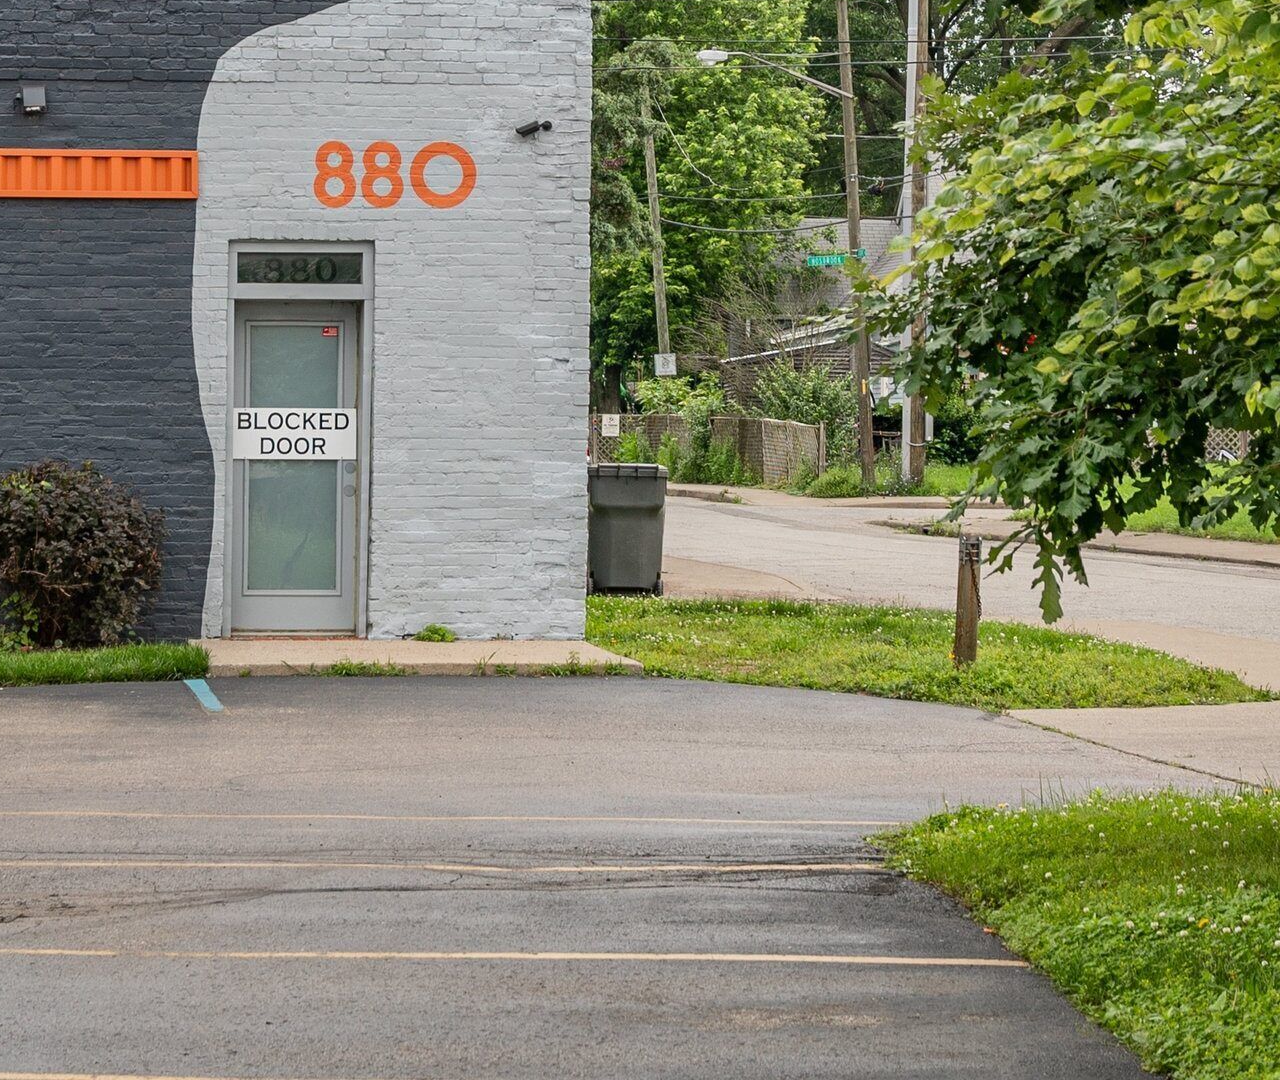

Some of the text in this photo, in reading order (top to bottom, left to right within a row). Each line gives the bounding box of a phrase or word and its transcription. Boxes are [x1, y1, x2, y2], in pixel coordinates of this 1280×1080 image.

[313, 140, 478, 209] 880
[264, 257, 337, 282] 880
[237, 412, 349, 430] BLOCKED
[260, 437, 326, 455] DOOR
